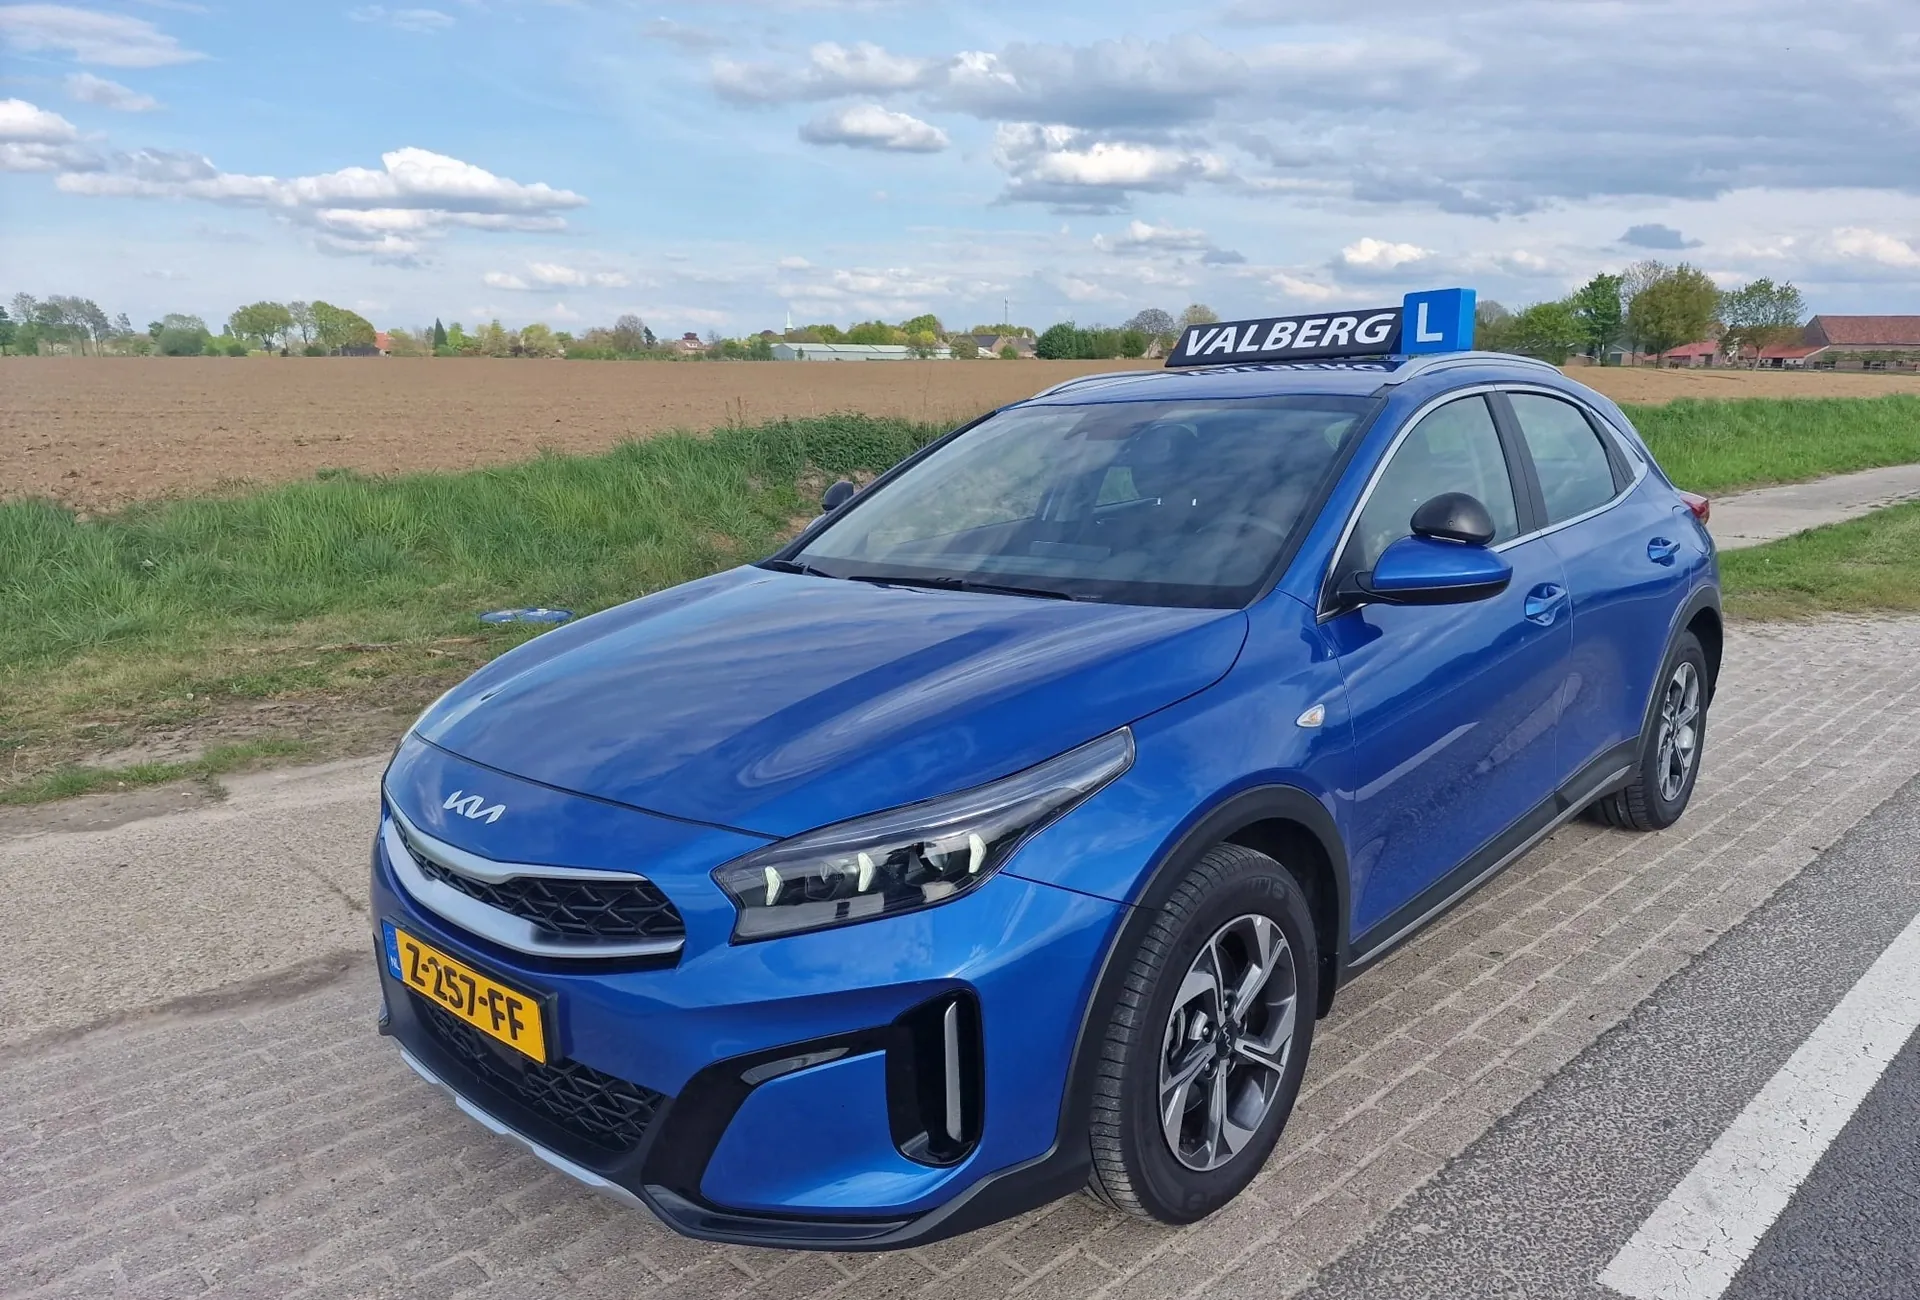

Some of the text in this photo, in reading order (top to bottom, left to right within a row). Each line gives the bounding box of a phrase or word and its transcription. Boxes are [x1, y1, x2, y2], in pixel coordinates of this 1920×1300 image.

[1185, 313, 1396, 356] VALBERG
[1416, 303, 1443, 343] L
[390, 955, 401, 971] NL
[406, 943, 524, 1040] Z-257-FF
